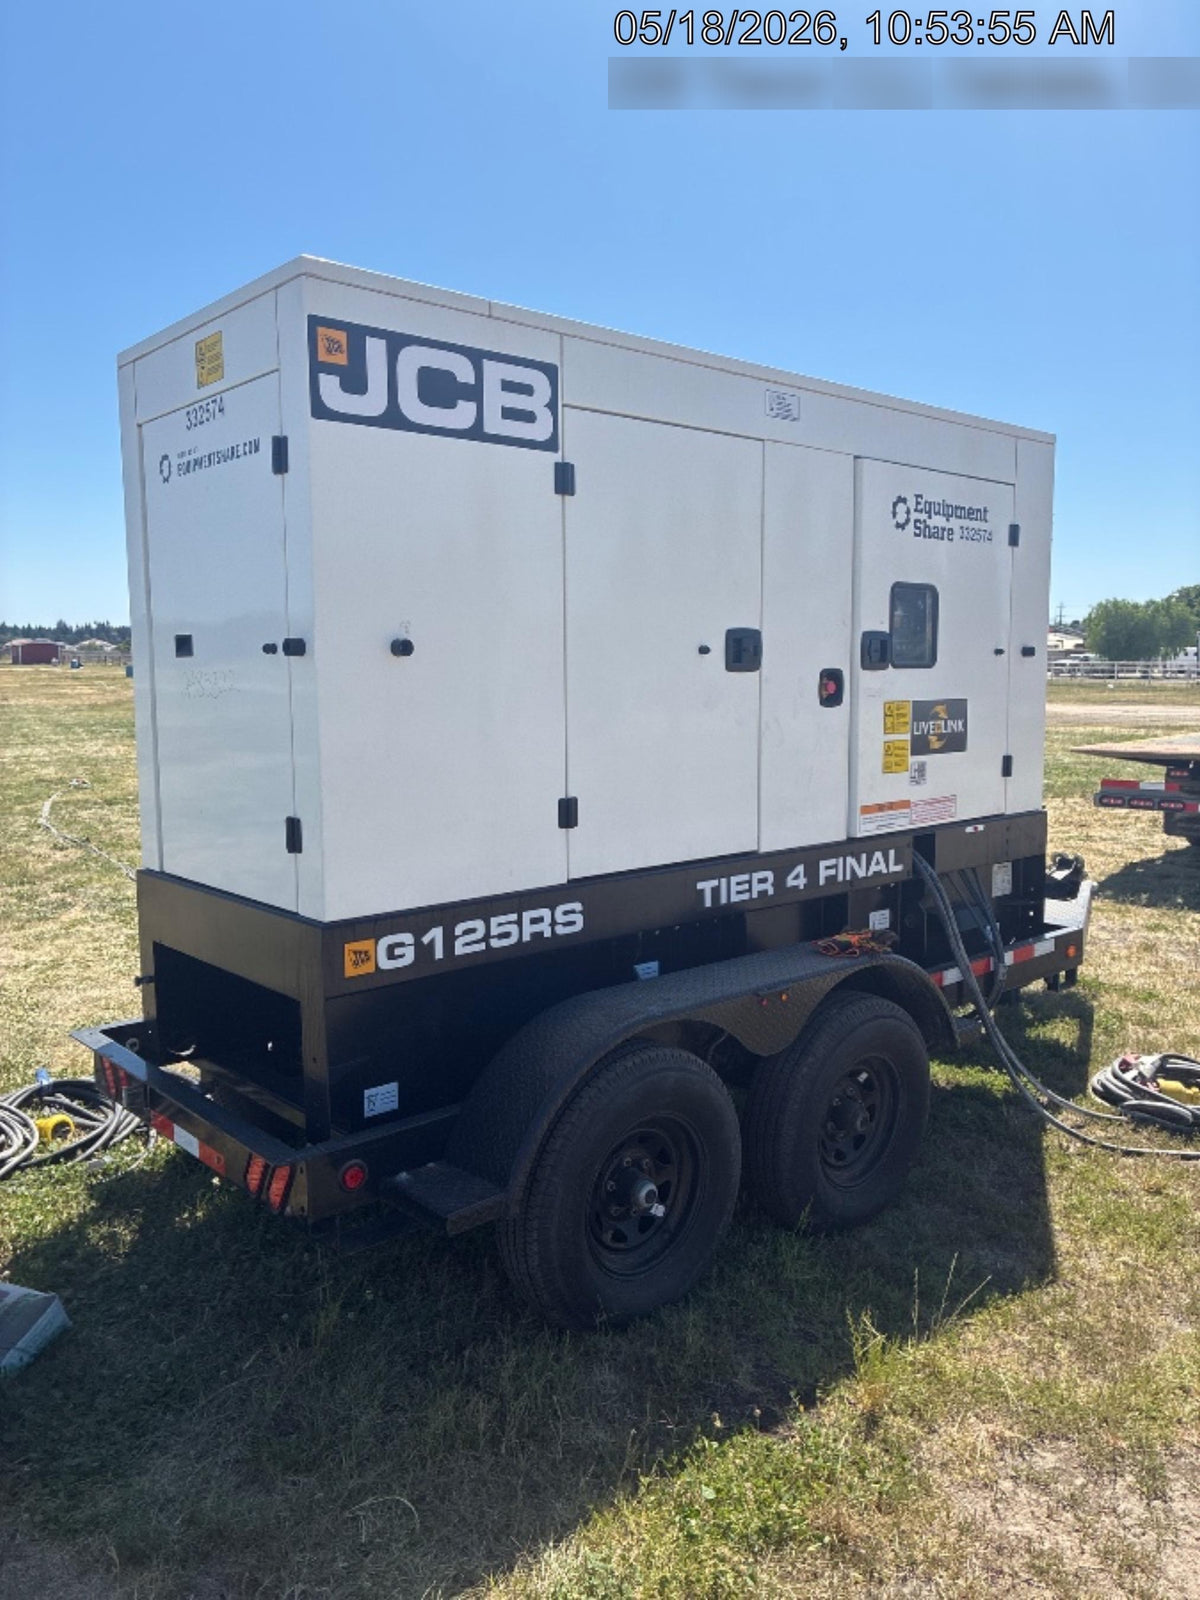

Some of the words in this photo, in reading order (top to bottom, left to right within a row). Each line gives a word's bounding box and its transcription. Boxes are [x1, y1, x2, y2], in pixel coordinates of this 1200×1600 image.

[318, 335, 554, 442] JCB
[185, 395, 225, 431] 332574
[913, 493, 989, 523] Equipment
[913, 519, 954, 541] Share
[696, 870, 774, 907] TIER
[785, 863, 808, 890] 4
[818, 849, 904, 886] FINAL
[376, 901, 584, 970] G125RS
